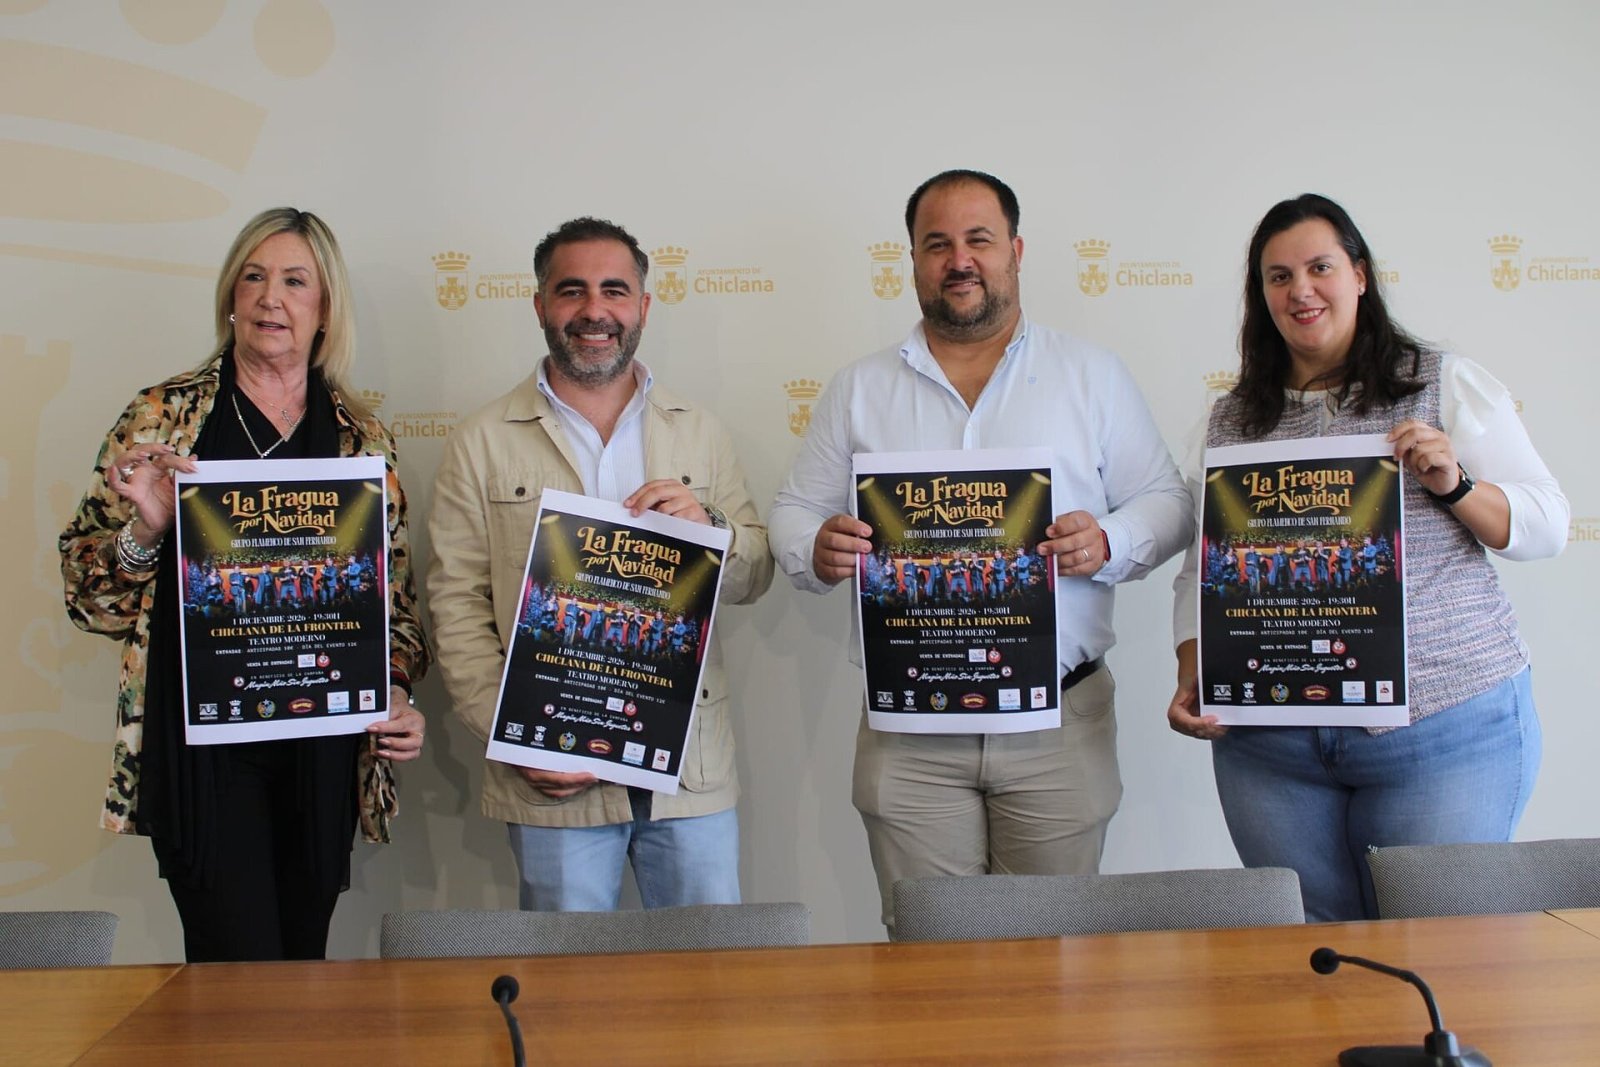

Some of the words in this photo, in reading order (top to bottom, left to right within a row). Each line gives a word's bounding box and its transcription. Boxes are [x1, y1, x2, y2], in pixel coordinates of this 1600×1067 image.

[1116, 269, 1193, 286] Chiclana
[1527, 264, 1600, 280] Chiclana
[694, 277, 774, 293] Chiclana
[1242, 471, 1276, 497] La
[1276, 465, 1355, 490] Fragua
[896, 481, 932, 509] La
[930, 476, 1008, 502] Fragua
[222, 490, 260, 518] La
[260, 486, 340, 511] Fragua
[1251, 496, 1278, 514] por
[1278, 489, 1352, 515] Navidad
[905, 507, 933, 524] por
[933, 501, 1005, 527] Navidad
[1248, 518, 1266, 528] GRUPO
[1267, 517, 1297, 527] FLAMENCO
[1298, 517, 1305, 526] DE
[1306, 516, 1319, 526] SAN
[1319, 515, 1351, 525] FERNANDO
[233, 517, 262, 534] por
[262, 510, 336, 536] Navidad
[904, 530, 922, 538] GRUPO
[923, 529, 952, 538] FLAMENCO
[953, 528, 960, 537] DE
[961, 528, 974, 537] SAN
[974, 526, 1005, 537] FERNANDO
[231, 539, 251, 548] GRUPO
[252, 537, 282, 547] FLAMENCO
[284, 537, 291, 546] DE
[291, 536, 304, 546] SAN
[305, 535, 337, 545] FERNANDO
[576, 527, 610, 555] La
[611, 530, 680, 565] Fragua
[581, 555, 608, 568] por
[606, 554, 674, 588] Navidad
[574, 572, 594, 583] GRUPO
[593, 576, 622, 589] FLAMENCO
[622, 581, 630, 590] DE
[629, 583, 642, 593] SAN
[641, 585, 672, 600] FERNANDO
[1247, 599, 1250, 607] 1
[1253, 598, 1299, 606] DICIEMBRE
[912, 608, 956, 616] DICIEMBRE
[1226, 608, 1280, 618] CHICLANA
[1284, 608, 1299, 617] DE
[1302, 608, 1315, 616] LA
[1319, 606, 1377, 616] FRONTERA
[233, 618, 236, 626] 1
[239, 615, 285, 626] DICIEMBRE
[885, 618, 938, 626] CHICLANA
[941, 618, 956, 626] DE
[958, 617, 971, 626] LA
[974, 616, 1031, 626] FRONTERA
[1262, 620, 1296, 628] TEATRO
[1298, 619, 1341, 627] MODERNO
[211, 626, 266, 638] CHICLANA
[270, 625, 285, 634] DE
[288, 624, 300, 633] LA
[304, 620, 361, 632] FRONTERA
[954, 628, 996, 636] MODERNO
[248, 636, 282, 646] TEATRO
[284, 634, 326, 643] MODERNO
[563, 648, 607, 662] DICIEMBRE
[534, 653, 587, 670] CHICLANA
[588, 662, 604, 672] DE
[605, 665, 618, 675] LA
[620, 668, 674, 688] FRONTERA
[566, 670, 598, 682] TEATRO
[599, 676, 639, 690] MODERNO
